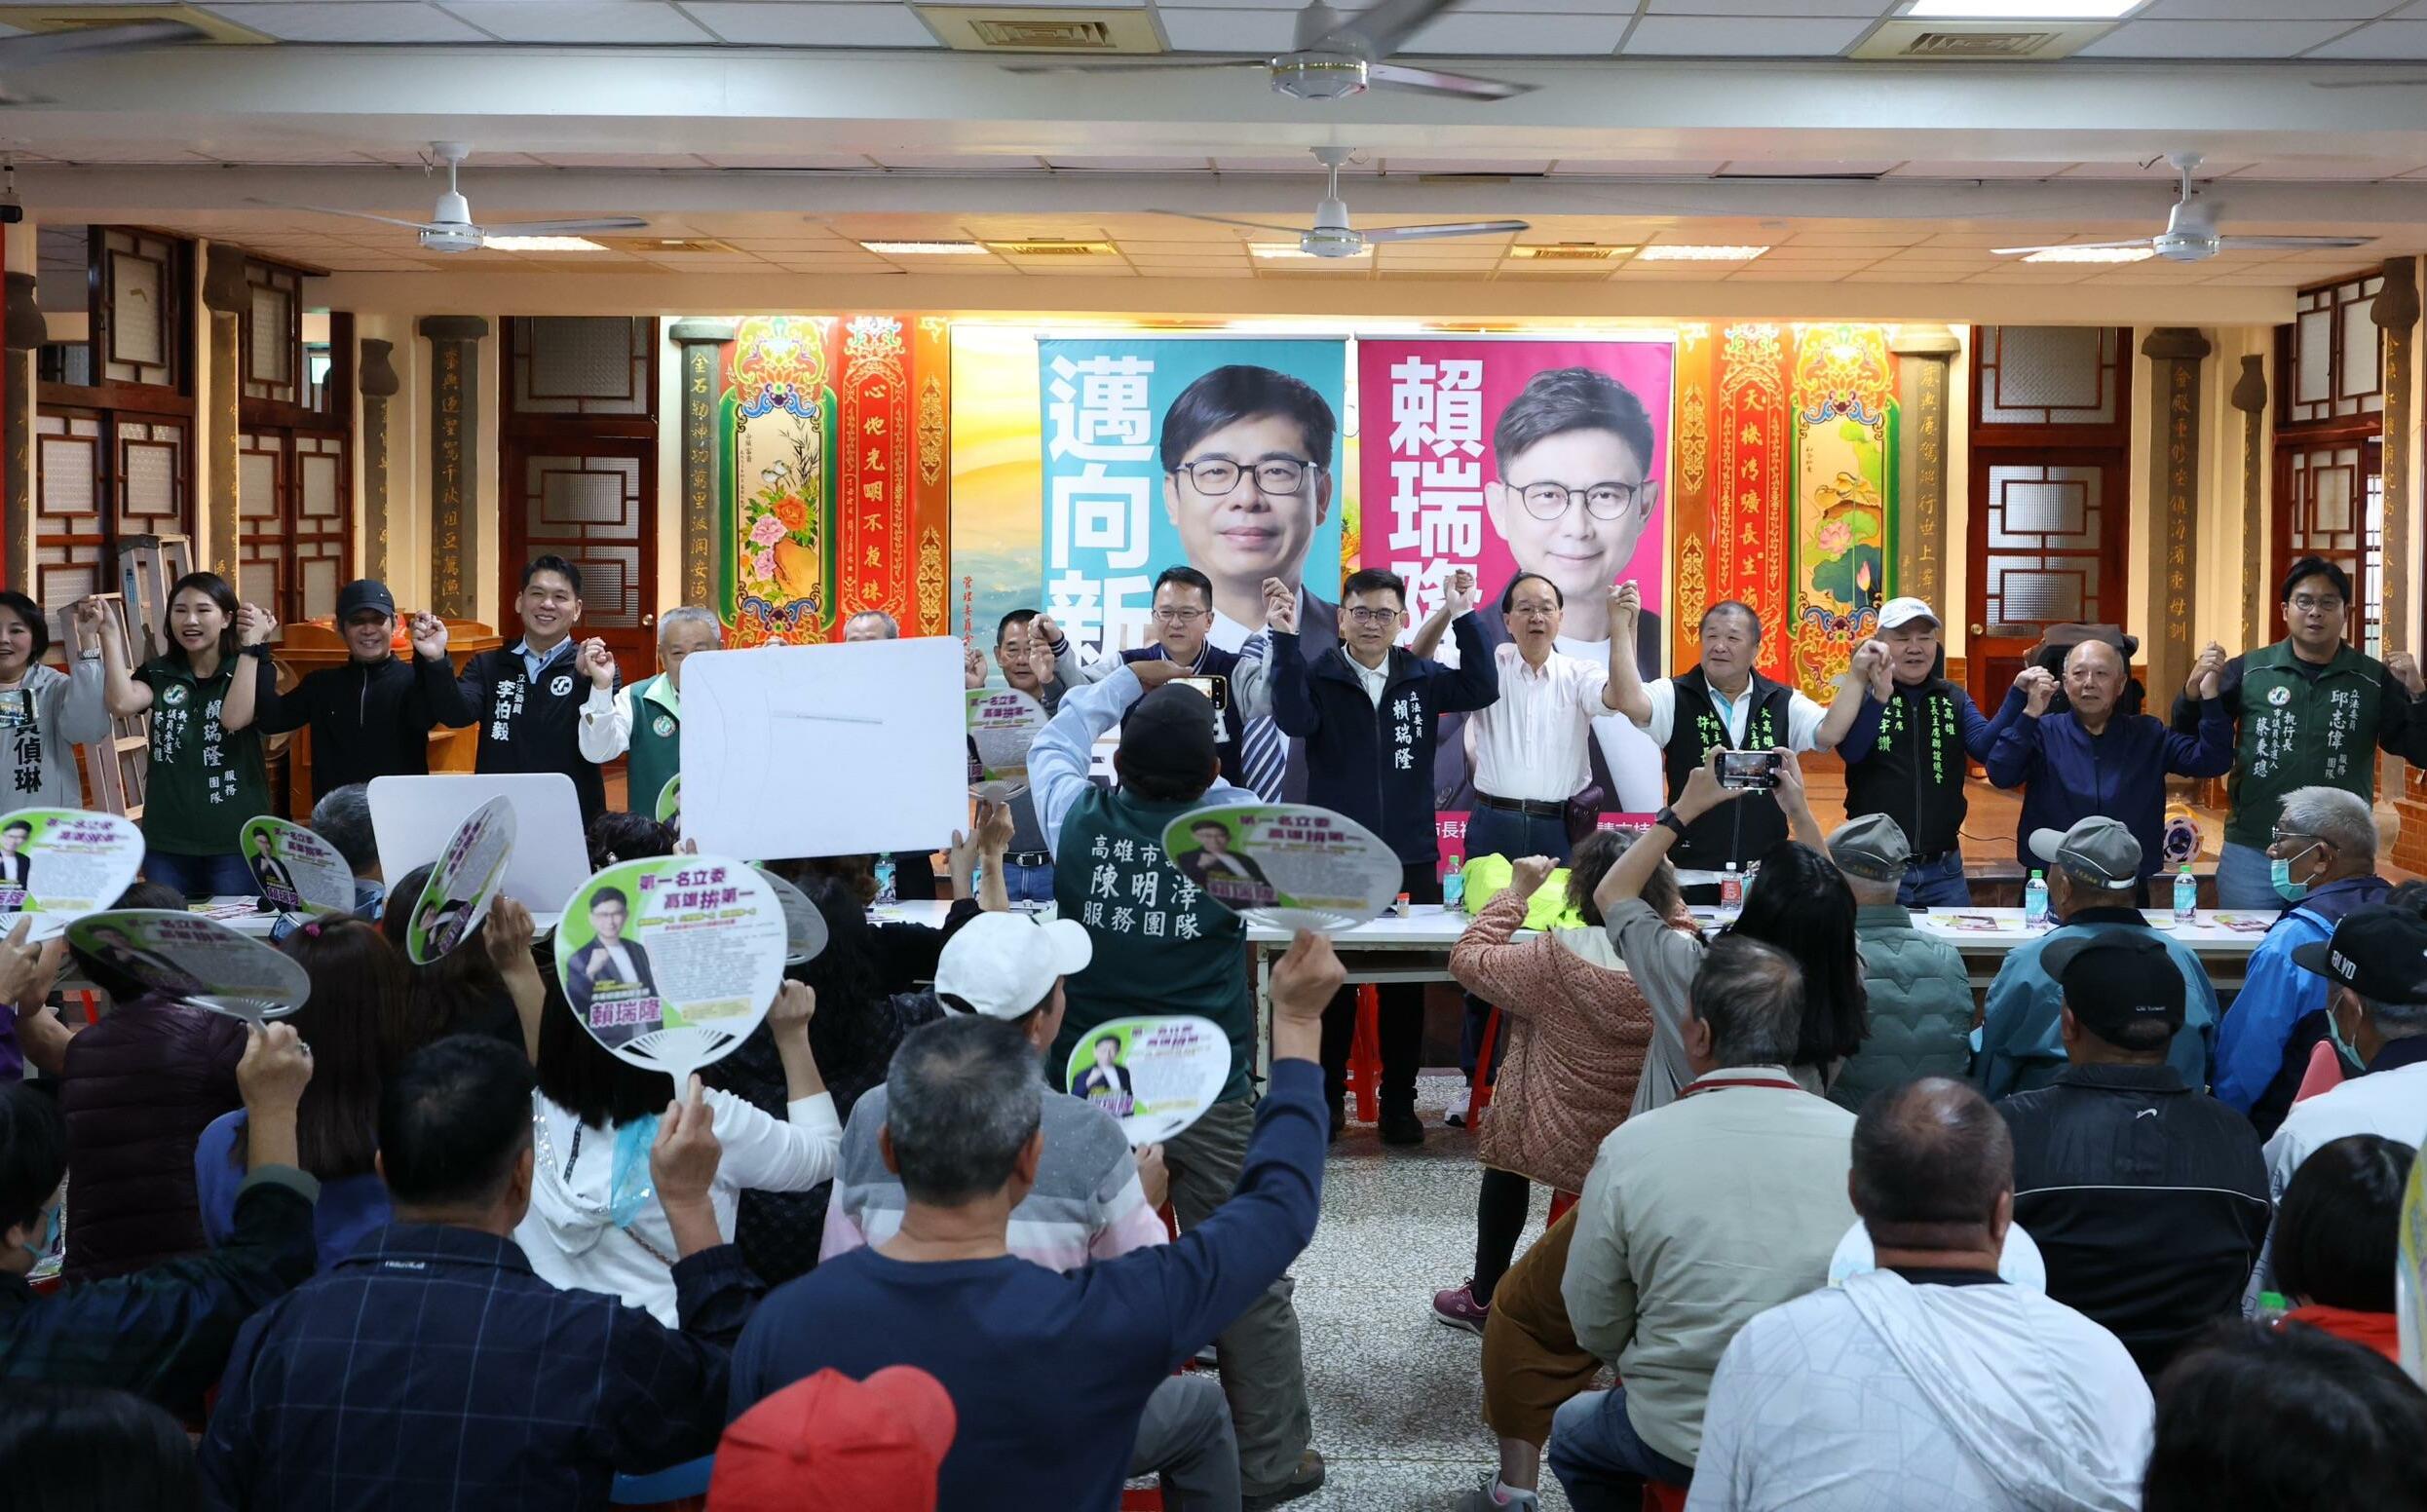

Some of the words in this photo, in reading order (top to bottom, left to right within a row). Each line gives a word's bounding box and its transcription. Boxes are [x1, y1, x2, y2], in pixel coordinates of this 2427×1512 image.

[861, 385, 888, 601] 心地光明不夜珠
[1047, 355, 1156, 668] 邁向新
[490, 679, 516, 741] 李柏毅
[512, 673, 526, 715] 立法委員
[1409, 690, 1423, 738] 立法委員
[2349, 688, 2361, 732] 立法委員
[203, 699, 225, 768] 賴瑞隆
[1392, 699, 1416, 770] 賴瑞隆
[1761, 707, 1775, 747] 大高雄
[1942, 696, 1955, 737] 大高雄
[2282, 711, 2297, 752] 執行長
[2327, 689, 2349, 751] 邱志偉
[1929, 696, 1945, 784] 里長主席聯誼總會
[2269, 707, 2283, 770] 市議員參選人
[224, 770, 237, 796] 服務
[2325, 756, 2337, 780] 團隊
[2337, 753, 2348, 776] 服務
[209, 775, 224, 805] 團隊
[1091, 834, 1177, 870] 高雄市
[639, 866, 727, 890] 第一名立委
[1090, 862, 1202, 913] 陳明澤
[1082, 900, 1203, 941] 服務團隊
[2332, 950, 2358, 980] BLVD
[590, 998, 662, 1026] 賴瑞隆
